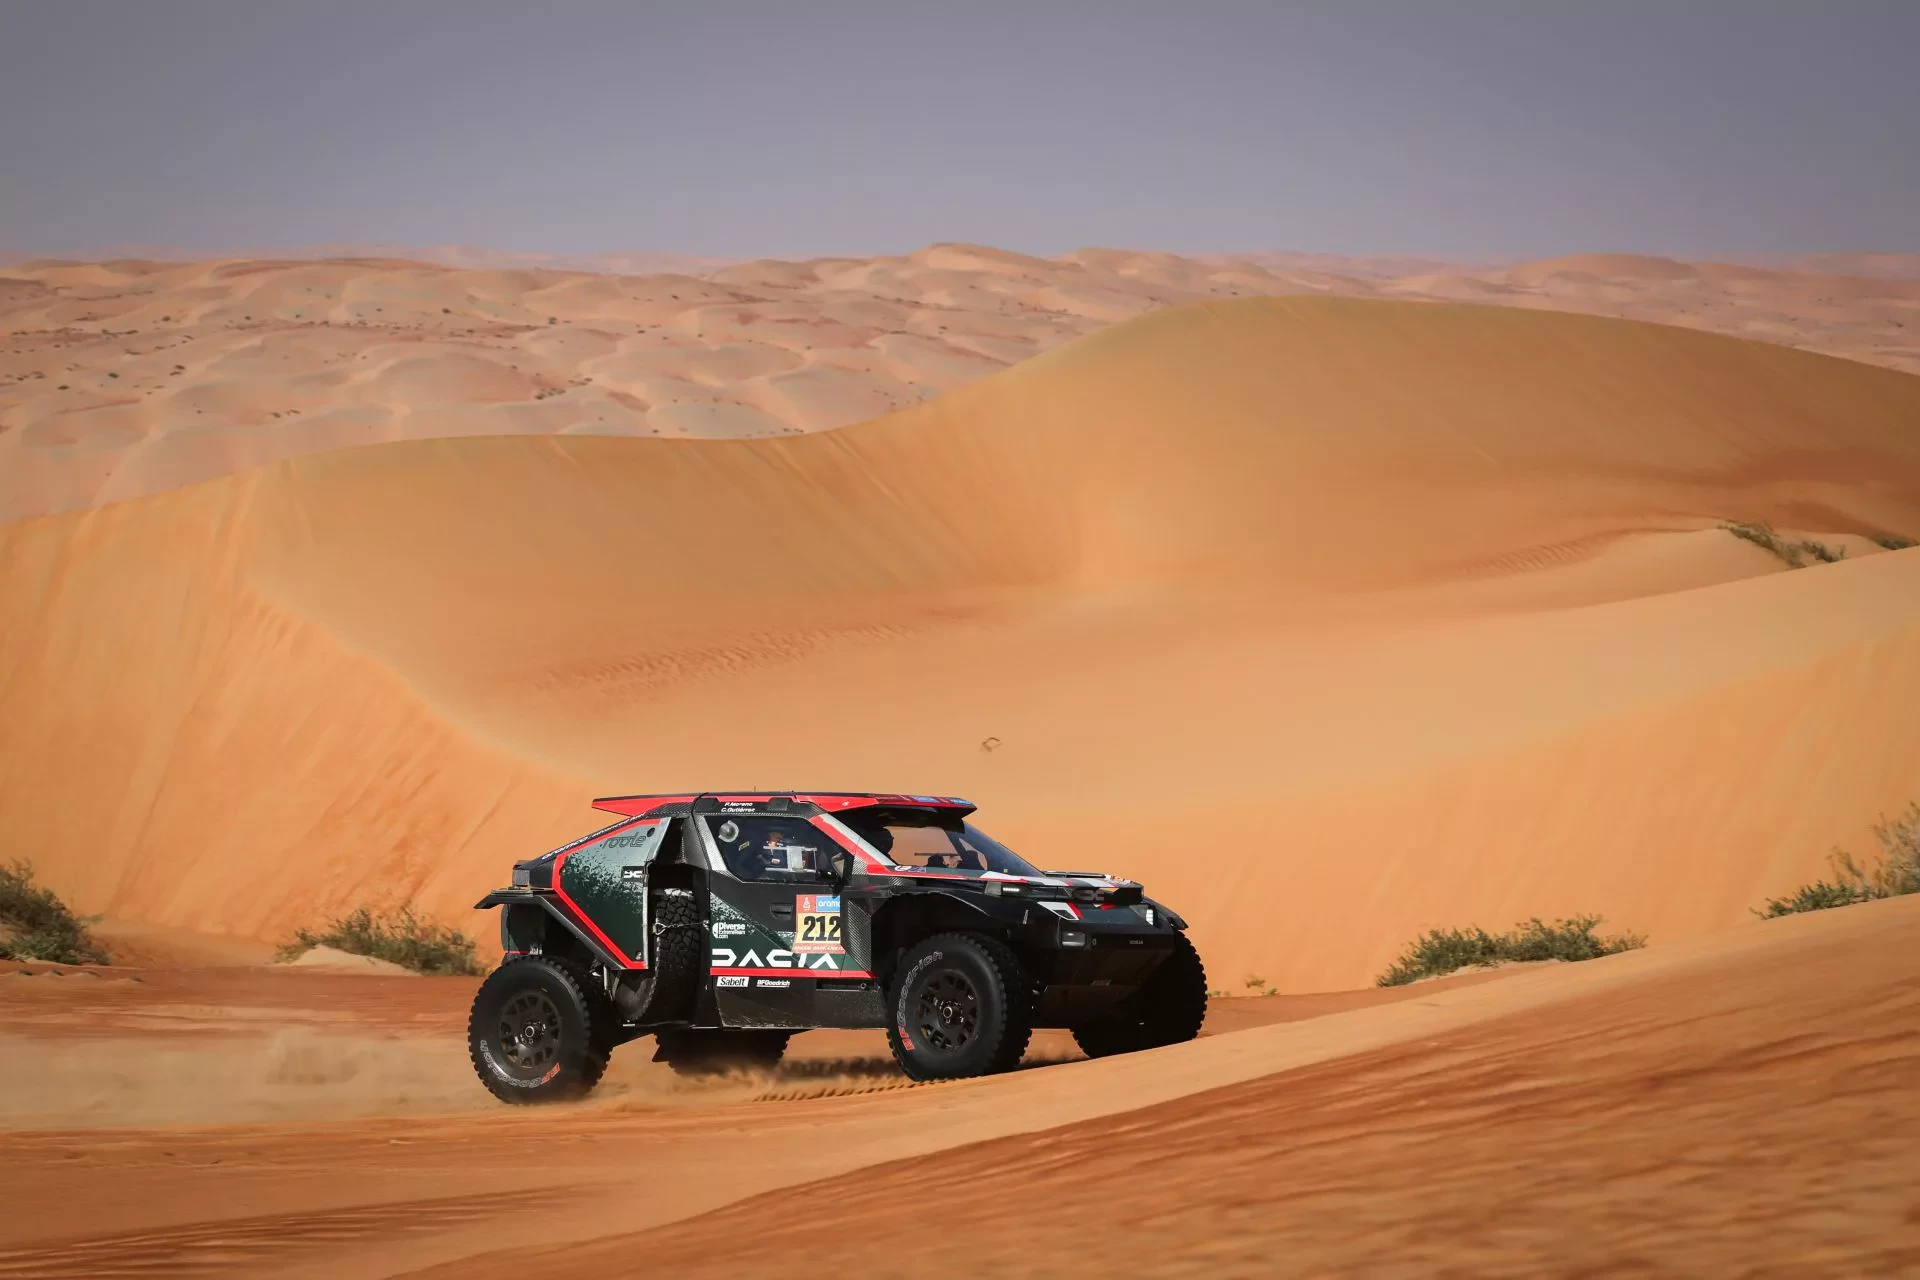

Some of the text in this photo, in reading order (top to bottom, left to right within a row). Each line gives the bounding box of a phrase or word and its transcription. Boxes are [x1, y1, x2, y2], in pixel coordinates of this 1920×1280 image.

[801, 915, 841, 942] 212
[712, 948, 840, 969] DACIA
[720, 977, 746, 986] Sabelt
